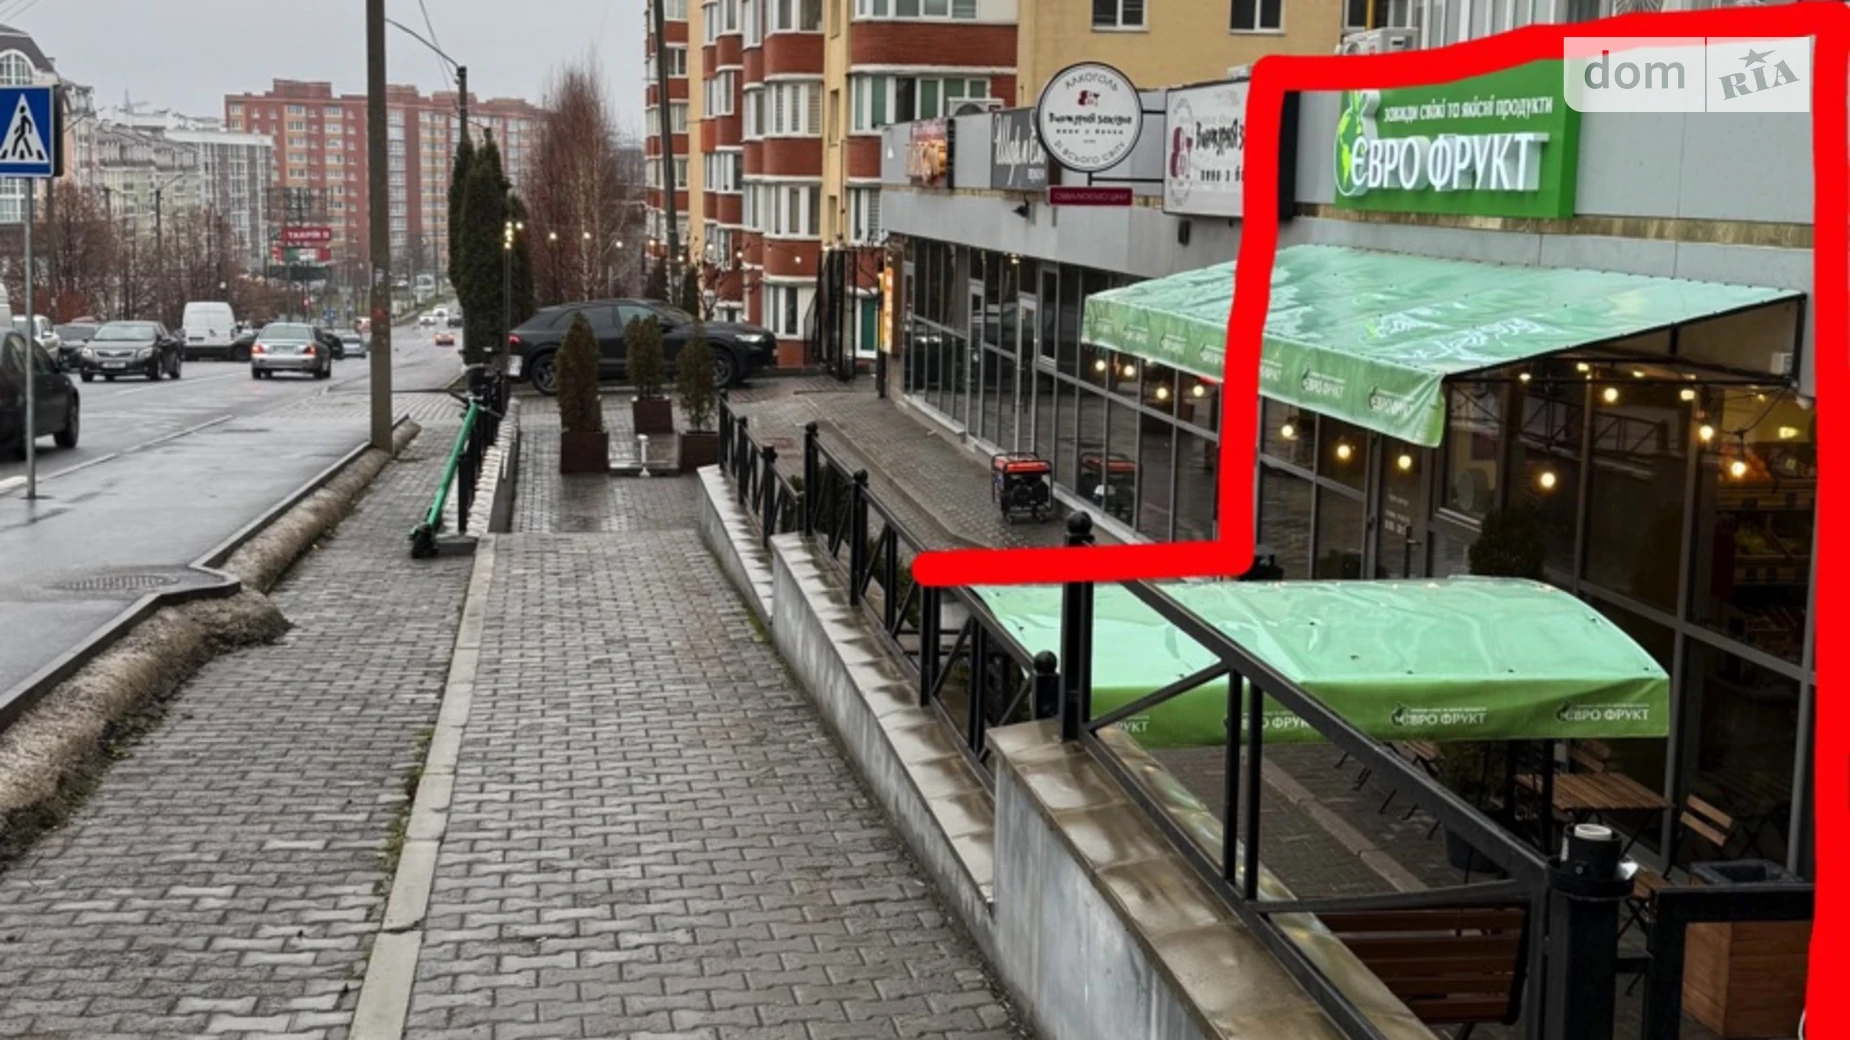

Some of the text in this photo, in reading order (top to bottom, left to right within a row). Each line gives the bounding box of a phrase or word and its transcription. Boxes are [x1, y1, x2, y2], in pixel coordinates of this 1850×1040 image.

[1065, 72, 1119, 92] АЛКОГОЛЬ
[1384, 95, 1553, 124] завжди свіжі та якісні продукти
[1351, 132, 1543, 192] ЄВРО ФРУКТ
[1271, 716, 1311, 729] ФРУК
[1440, 711, 1487, 725] ФРУКТ
[1603, 707, 1650, 721] ФРУКТ
